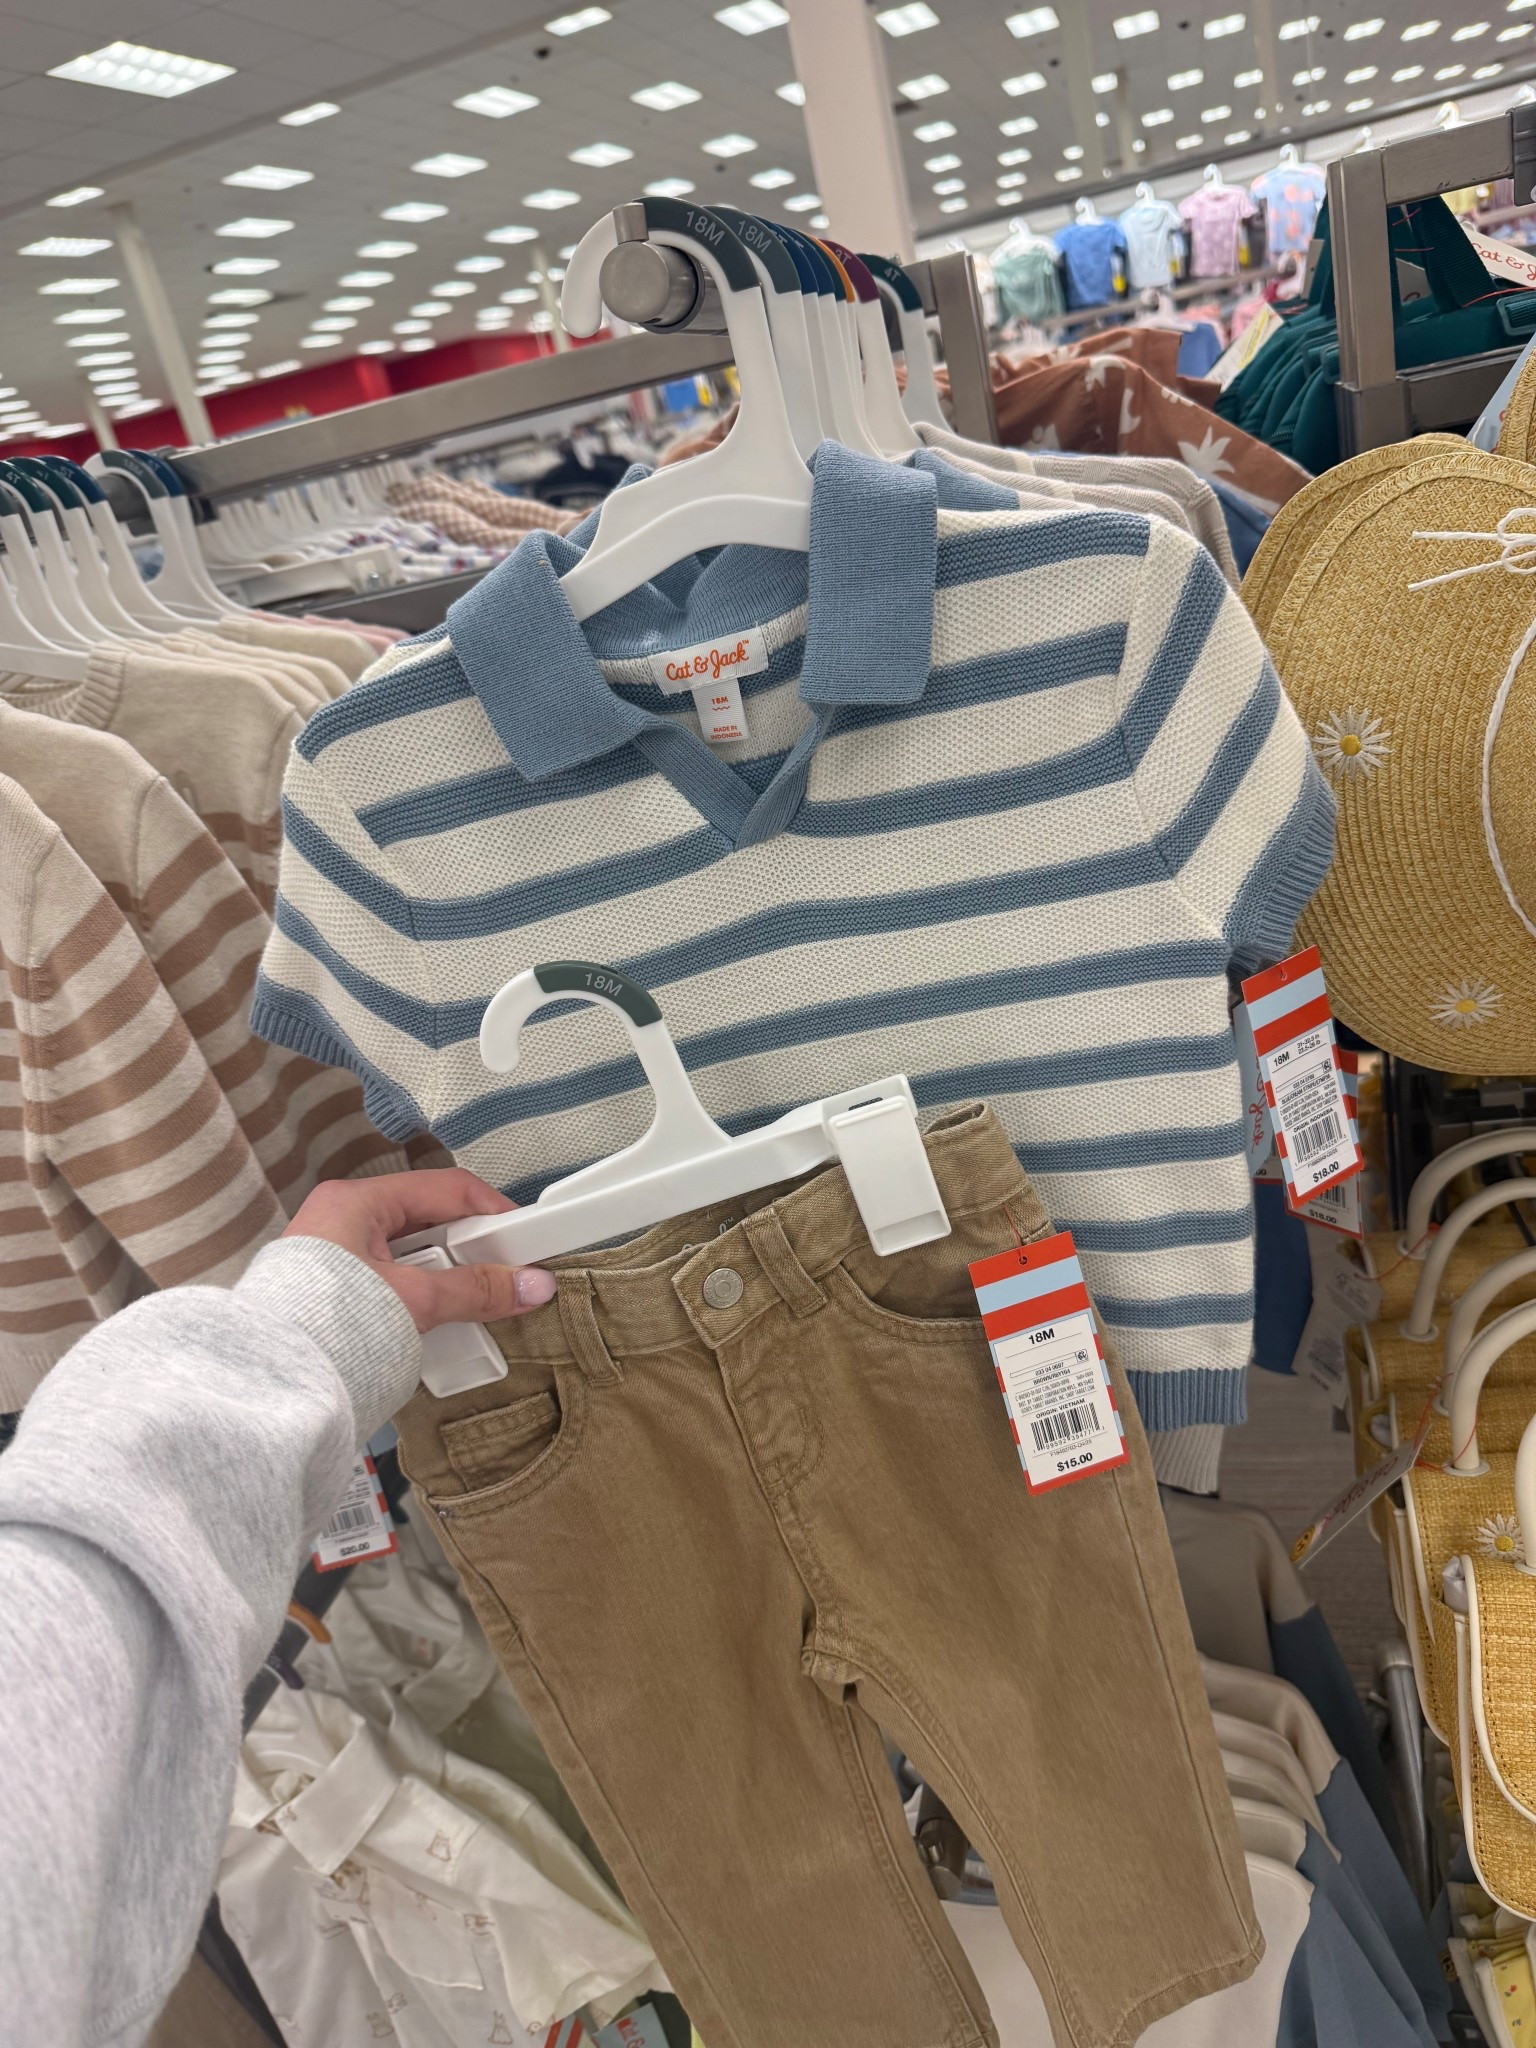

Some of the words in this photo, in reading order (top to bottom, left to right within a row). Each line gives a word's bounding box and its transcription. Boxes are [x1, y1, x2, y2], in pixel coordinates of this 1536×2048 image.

[685, 210, 726, 247] 18M
[736, 219, 773, 254] 18M
[1505, 255, 1525, 270] &
[883, 266, 900, 282] 4T
[665, 661, 694, 681] Cat
[693, 655, 709, 674] &
[711, 695, 729, 705] 18M
[713, 725, 730, 733] MADE
[584, 972, 623, 997] 18M
[1273, 1051, 1290, 1067] 18M
[1312, 1160, 1340, 1183] $18.00
[1309, 1209, 1337, 1224] $18.00
[1028, 1327, 1055, 1345] 18M
[1035, 1407, 1059, 1419] ORIGIN:
[1059, 1398, 1086, 1411] VIETNAM
[1056, 1452, 1093, 1473] $15.00
